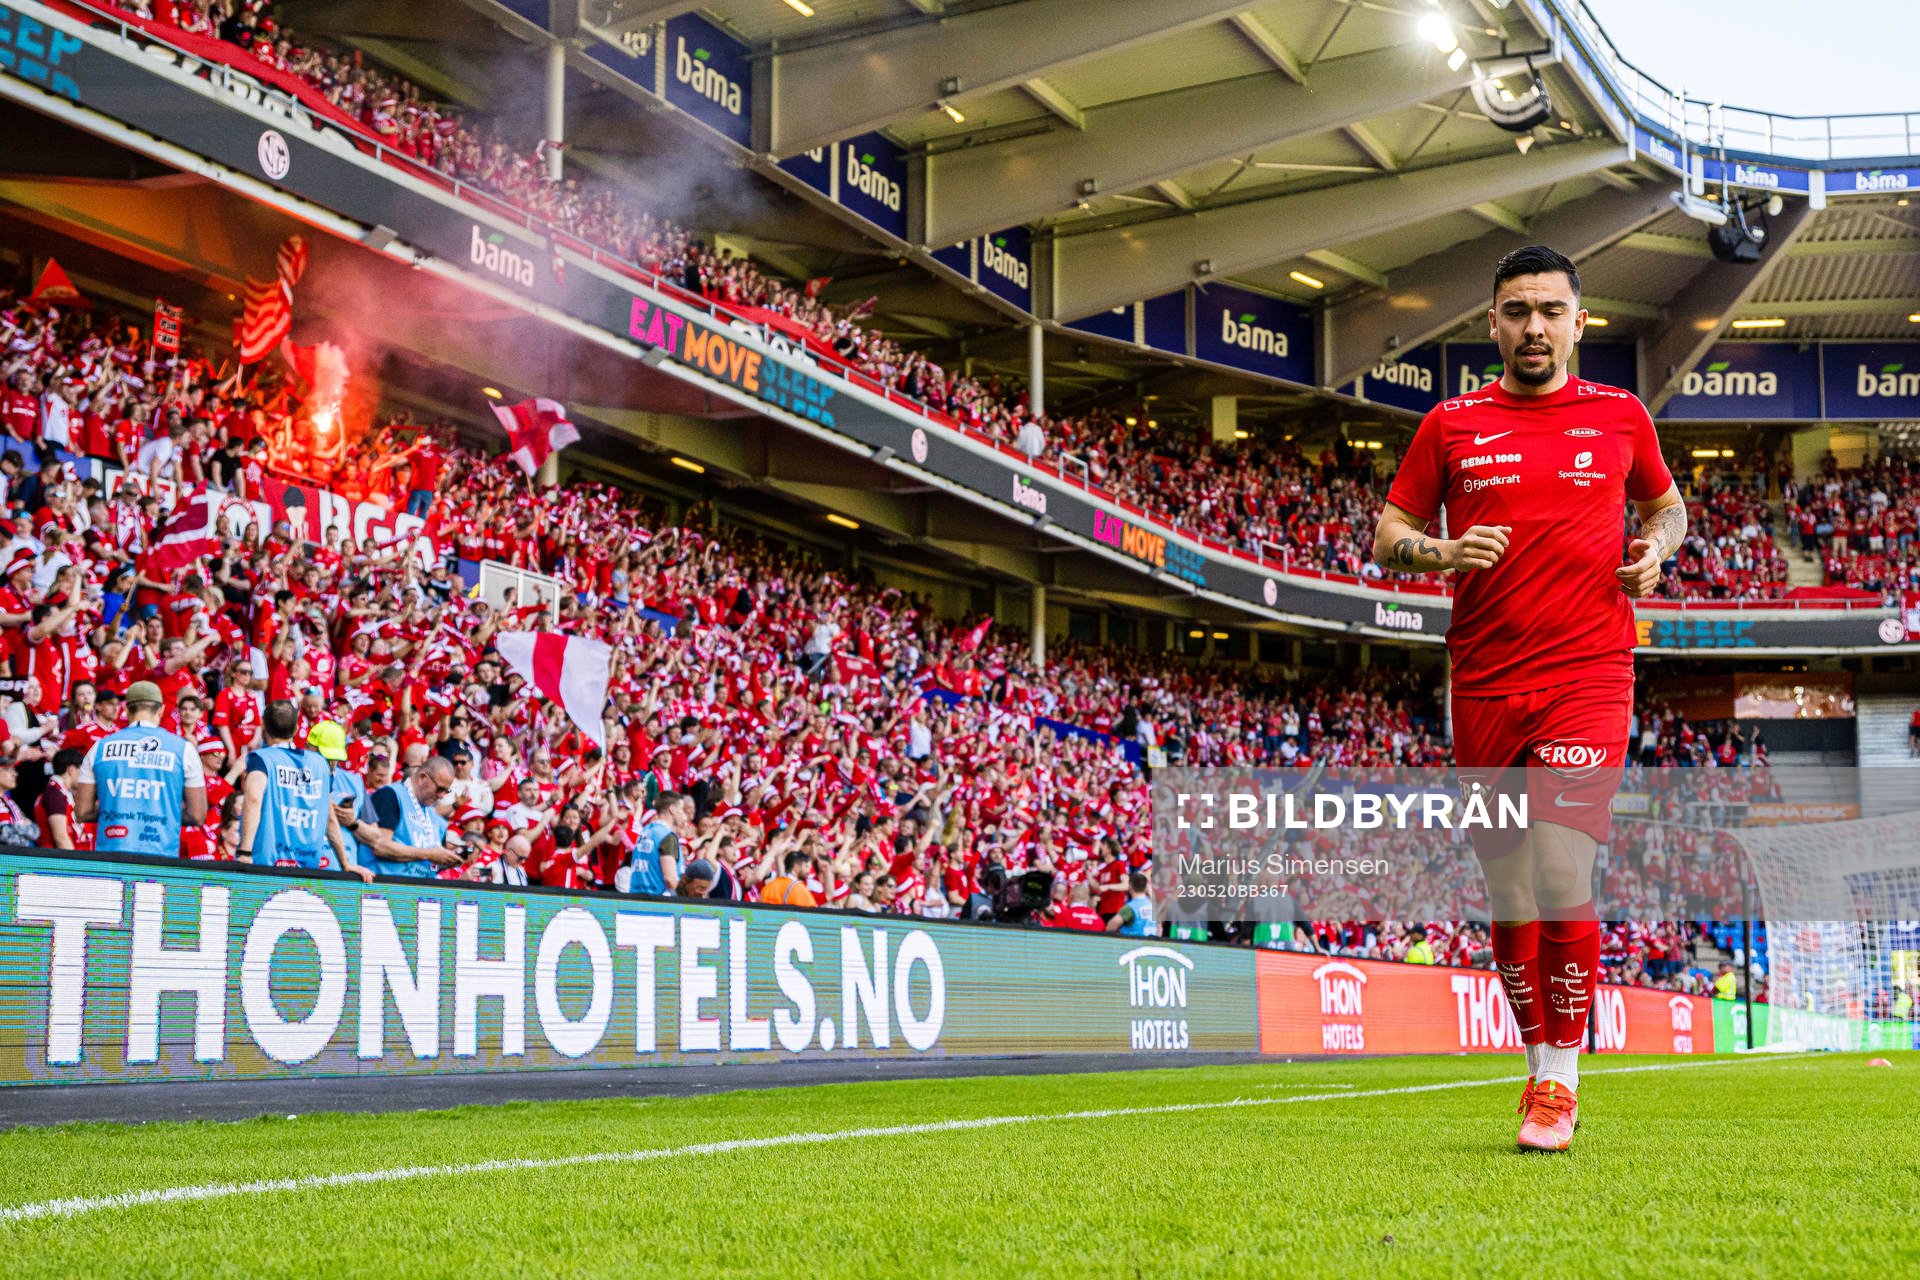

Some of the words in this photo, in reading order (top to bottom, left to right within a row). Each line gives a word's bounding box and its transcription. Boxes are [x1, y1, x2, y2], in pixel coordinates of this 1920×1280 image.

[676, 36, 742, 115] bama
[1650, 136, 1676, 164] bama
[846, 144, 901, 212] bama
[1735, 165, 1779, 188] bama
[1856, 172, 1908, 191] bama
[470, 225, 535, 287] bama
[983, 233, 1029, 290] bama
[629, 296, 684, 353] EAT
[684, 321, 762, 392] MOVE
[1222, 309, 1288, 357] bama
[1857, 364, 1920, 397] bam
[1571, 428, 1596, 436] BRANN
[1461, 455, 1493, 469] REMA
[1495, 453, 1522, 463] 1000
[1558, 470, 1606, 480] Sparebanken
[1013, 473, 1047, 514] bama
[1473, 474, 1521, 490] Fjordkraft
[1574, 479, 1591, 487] Vest
[1094, 509, 1123, 548] EAT
[1122, 523, 1166, 567] MOVE
[1375, 602, 1423, 630] bama
[106, 742, 138, 758] ELITE
[1540, 745, 1603, 767] ERØY
[106, 777, 166, 801] VERT
[15, 873, 946, 1067] THONHOTELS.NO
[1119, 946, 1194, 1008] THON
[1313, 962, 1367, 1016] THON
[1131, 1020, 1189, 1050] HOTELS
[1322, 1024, 1365, 1051] HOTELS
